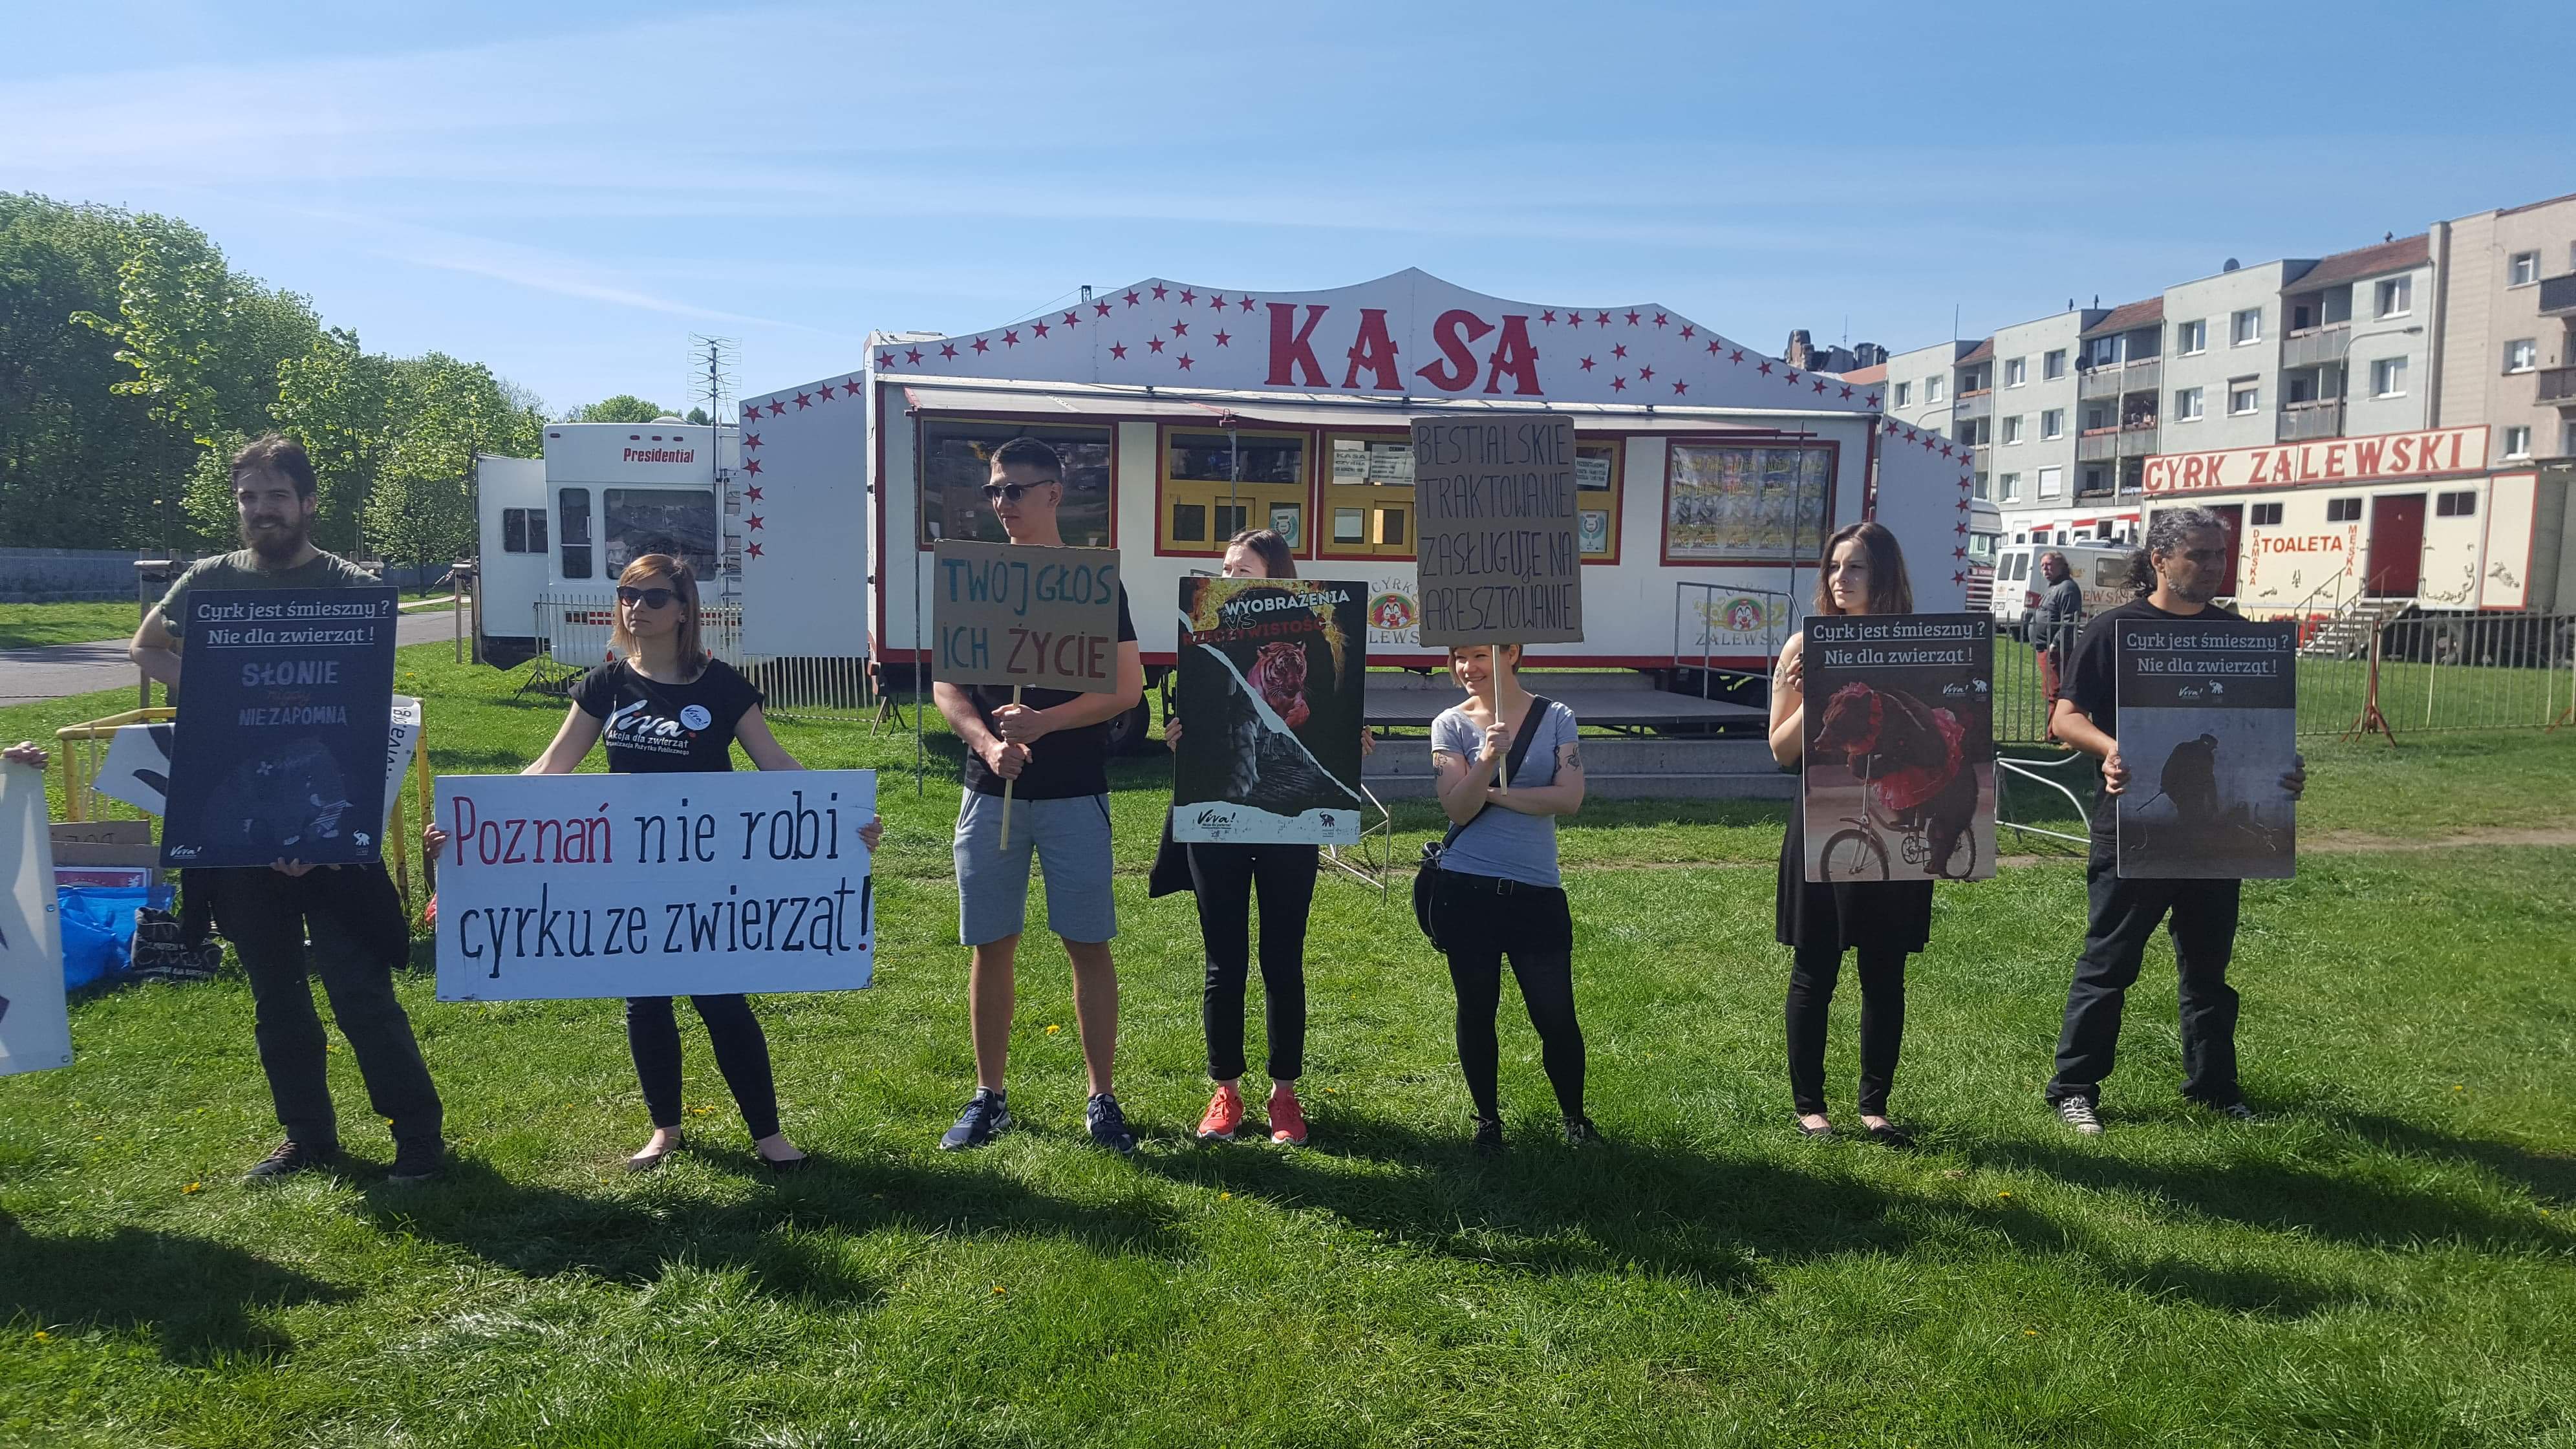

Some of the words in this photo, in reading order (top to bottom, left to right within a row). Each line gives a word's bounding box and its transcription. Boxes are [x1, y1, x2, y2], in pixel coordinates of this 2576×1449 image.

[1264, 303, 1544, 395] KASA
[623, 448, 694, 463] Presidential
[1418, 424, 1569, 466] BESTIALSKIE
[2145, 455, 2227, 491] CYRK
[2248, 433, 2465, 484] ZALEWSKI
[1419, 473, 1572, 519] TRAKTOWANIE
[1421, 531, 1541, 583] ZASŁUGUJE
[1549, 531, 1572, 576] NA
[2249, 529, 2260, 585] DAMSKA
[2262, 536, 2343, 553] TOALETA
[1036, 564, 1115, 604] GŁOS
[1371, 575, 1413, 594] CYRK
[197, 602, 244, 621] Cyrk
[248, 603, 283, 620] jest
[287, 600, 376, 618] śmieszny
[381, 600, 390, 615] ?
[1225, 589, 1351, 615] WYOBRAŻENIA
[1426, 584, 1575, 632] ARESZTOWANIE
[1183, 616, 1326, 645] RZECZYWISTOŚĆ
[1225, 613, 1257, 630] VS
[1813, 623, 1854, 641] Cyrk
[1857, 623, 1889, 641] jest
[1893, 621, 1973, 639] śmieszny
[1977, 621, 1986, 636] ?
[207, 629, 240, 645] Nie
[244, 628, 275, 644] dla
[279, 626, 365, 645] zwierząt
[369, 627, 374, 641] !
[2127, 633, 2165, 649] Cyrk
[2168, 633, 2197, 650] jest
[2201, 632, 2277, 650] śmieszny
[2281, 634, 2289, 649] ?
[1006, 623, 1109, 678] ŻYCIE
[1825, 650, 1852, 665] Nie
[1857, 649, 1885, 663] dla
[1888, 648, 1964, 664] zwierząt
[1969, 647, 1973, 661] !
[241, 660, 341, 687] SŁONIE
[2137, 658, 2163, 672] Nie
[2167, 658, 2193, 672] dla
[2197, 658, 2269, 676] zwierząt
[2273, 659, 2277, 673] !
[608, 731, 630, 741] Akcja
[633, 733, 645, 743] dla
[648, 737, 689, 749] zwierząt
[452, 796, 612, 866] Poznań
[634, 797, 716, 863] nie
[740, 790, 839, 861] robi
[1197, 809, 1236, 825] Viva!
[460, 883, 595, 979] cyrku
[603, 906, 647, 955] ze
[663, 875, 871, 956] zwierząt!
